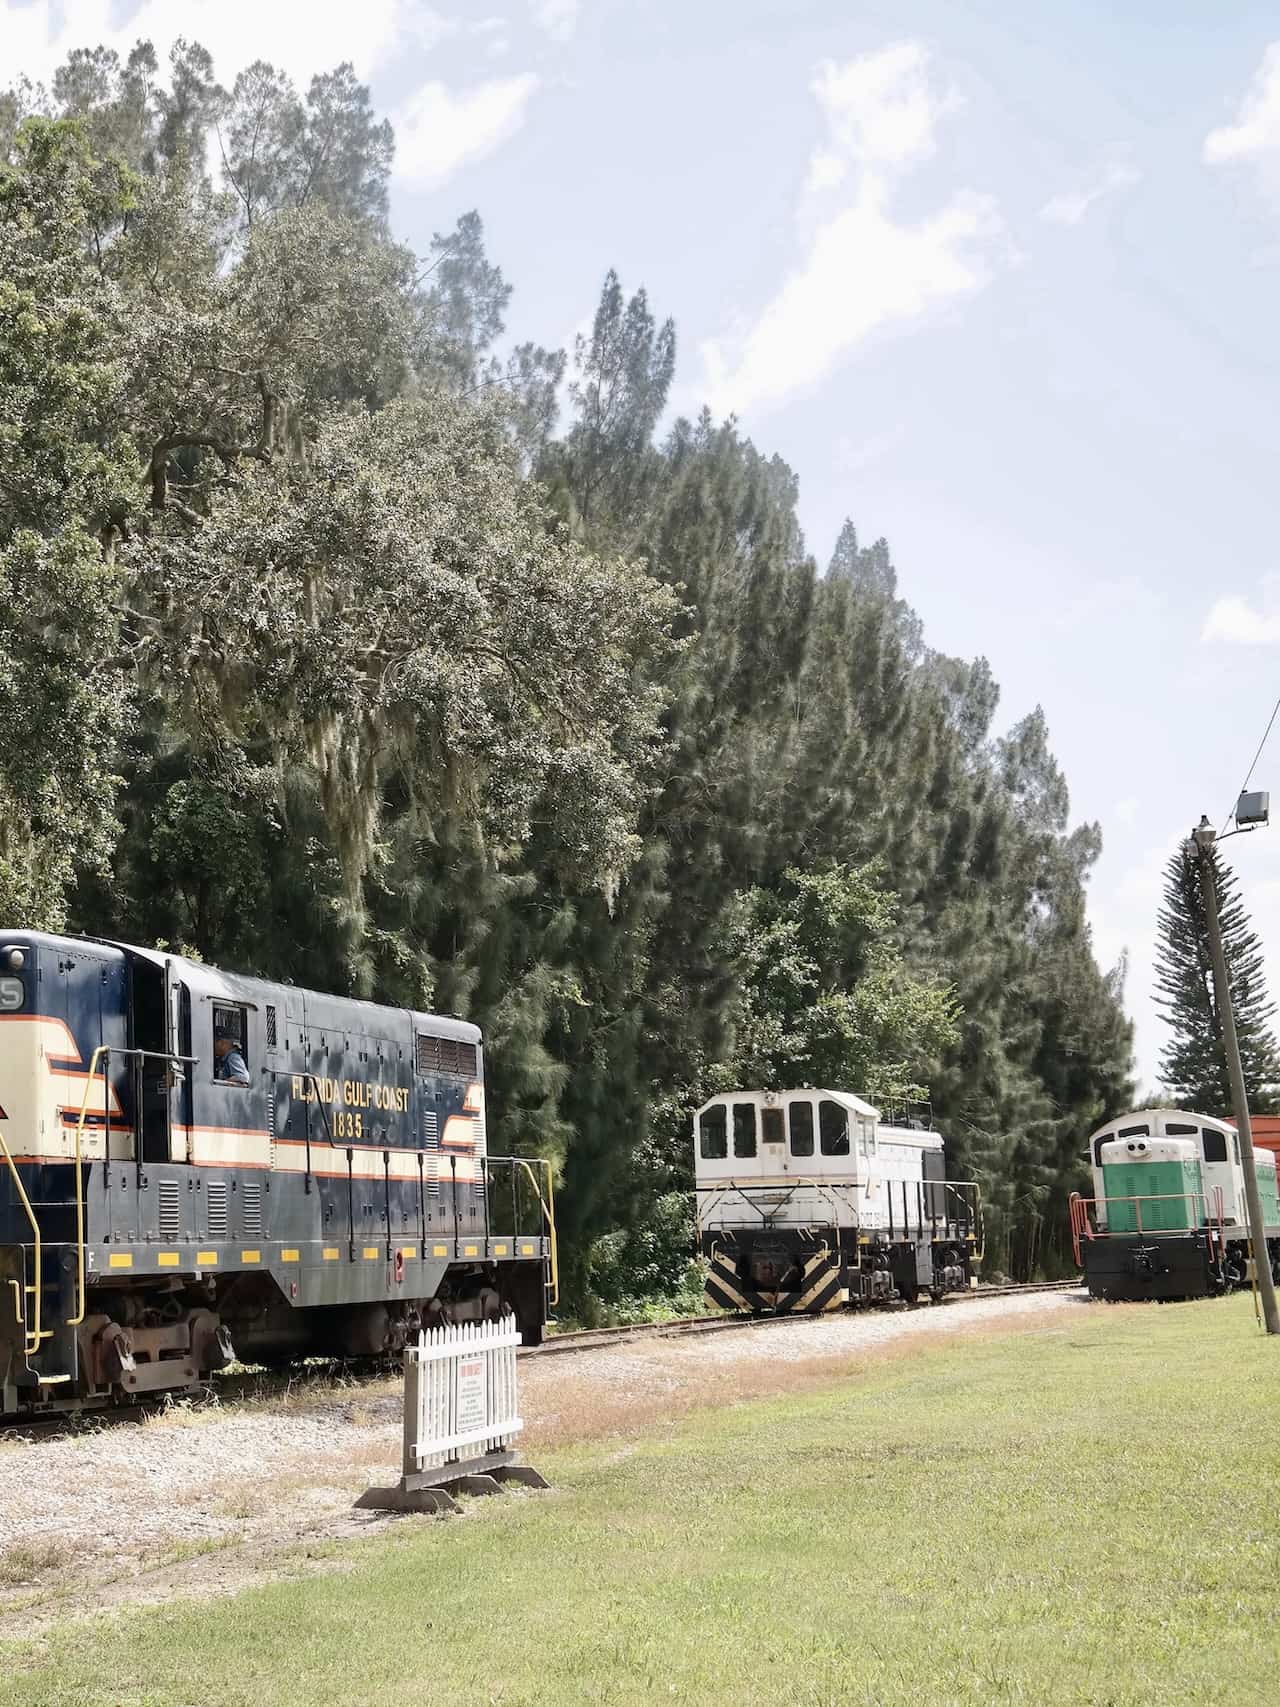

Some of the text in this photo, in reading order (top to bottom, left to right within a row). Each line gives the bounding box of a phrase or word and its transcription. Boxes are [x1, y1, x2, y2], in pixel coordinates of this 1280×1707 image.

[344, 1081, 372, 1108] GULF
[375, 1085, 409, 1112] COAST
[333, 1111, 362, 1138] 1835
[88, 1251, 95, 1269] F
